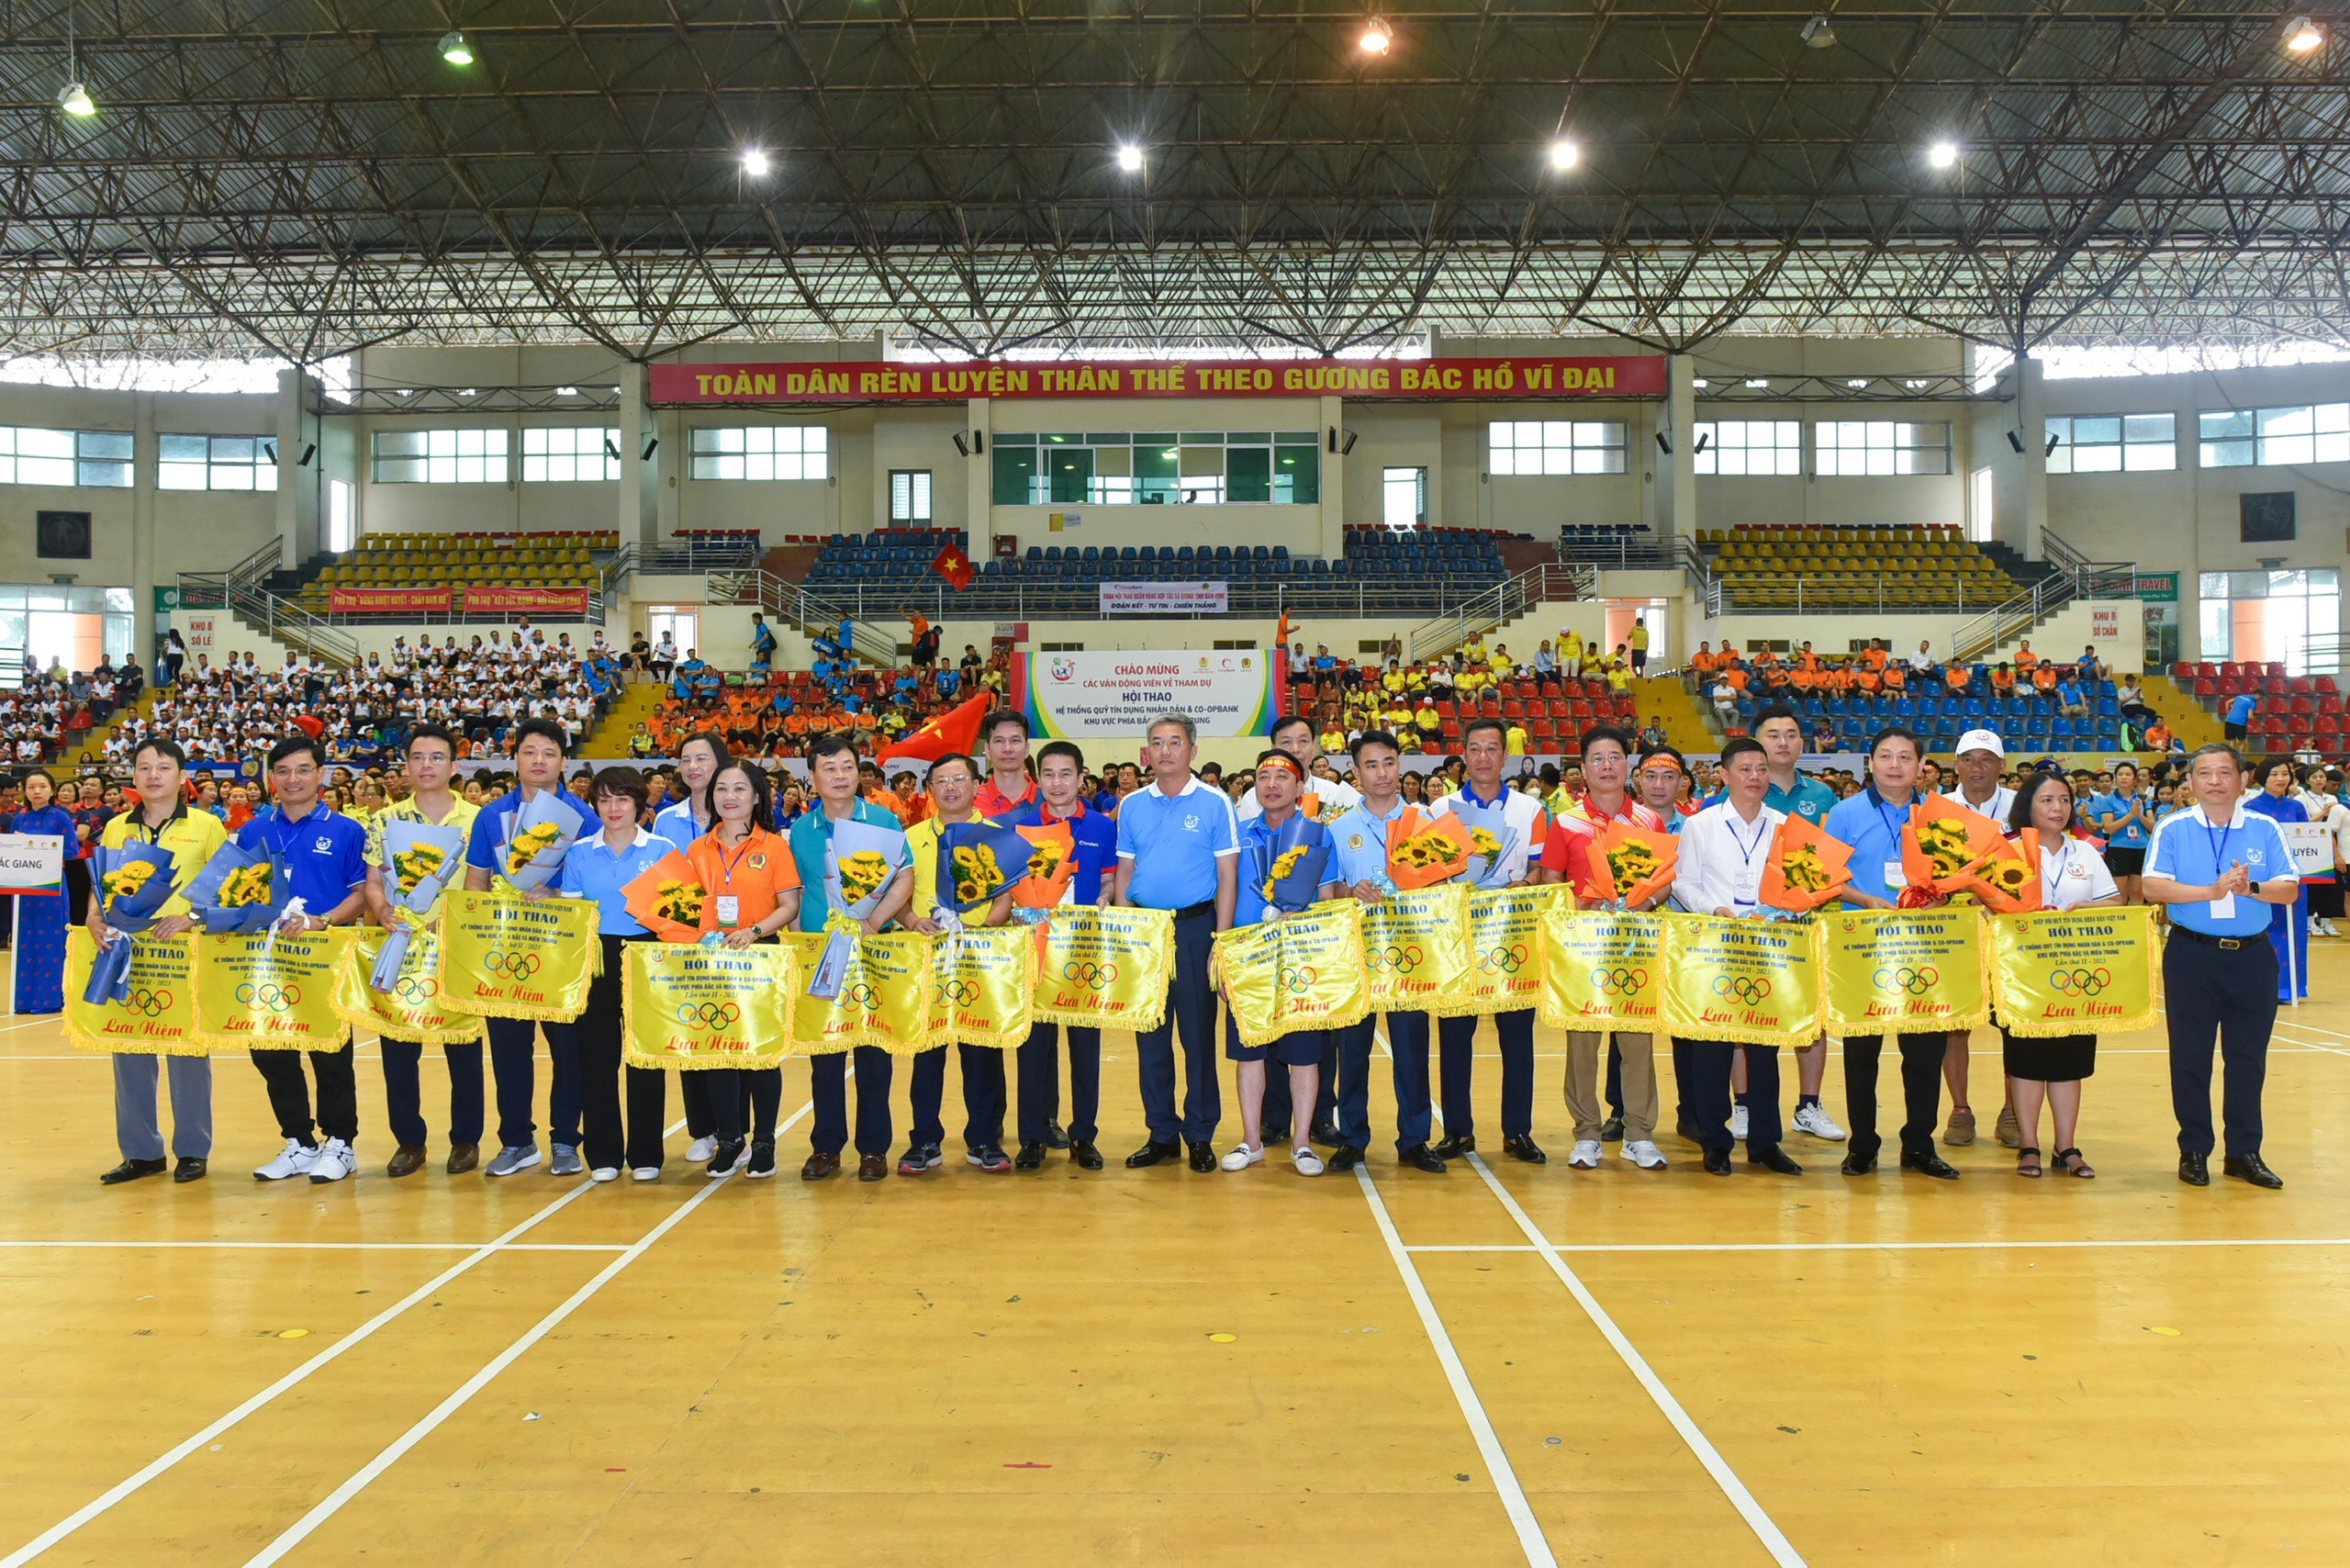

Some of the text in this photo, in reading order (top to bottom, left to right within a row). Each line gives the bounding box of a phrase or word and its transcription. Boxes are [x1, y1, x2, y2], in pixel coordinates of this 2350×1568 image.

[696, 361, 1615, 396] TOÀN DÂN RÈN LUYỆN THÂN THỂ THEO GƯƠNG BÁC HỒ VĨ ĐẠI
[2136, 578, 2172, 590] TRAVEL
[2094, 611, 2116, 622] KHU B
[191, 621, 212, 631] KHU B
[2093, 626, 2100, 636] SỐ
[191, 633, 201, 645] SỐ
[1114, 663, 1144, 675] CHÀO
[1147, 663, 1179, 675] MỪNG
[1083, 678, 1098, 688] CÁC
[1100, 678, 1116, 689] VẬN
[1118, 678, 1141, 689] ĐỘNG
[1144, 678, 1160, 687] VIÊN
[1201, 679, 1212, 689] DỰ
[1123, 689, 1171, 704] HỘI THAO
[1056, 705, 1065, 716] HỆ
[1067, 704, 1091, 714] THỐNG
[1093, 705, 1109, 714] QUỸ
[1110, 705, 1122, 713] TÍN
[1124, 707, 1144, 716] DỤNG
[1146, 704, 1168, 713] NHÂN
[1169, 704, 1185, 713] DÂN
[1194, 705, 1239, 713] CO-OPBANK
[1102, 717, 1116, 726] VỰC
[1118, 716, 1135, 724] PHÍA
[2293, 846, 2318, 857] UYÊN
[0, 856, 42, 868] ẮC GIANG
[494, 908, 558, 924] HỘI THAO
[1070, 919, 1132, 933] HỘI THAO
[1874, 924, 1944, 937] HỘI THAO
[2048, 925, 2113, 938] HỘI THAO
[1720, 933, 1786, 947] HỘI THAO
[684, 958, 753, 971] HỘI THAO
[474, 980, 545, 1004] Lưu Niệm
[1052, 991, 1125, 1014] Lưu Niệm
[1580, 999, 1656, 1019] Lưu Niệm
[1863, 999, 1951, 1017] Lưu Niệm
[2042, 1001, 2124, 1018] Lưu Niệm
[1699, 1006, 1779, 1028] Lưu Niệm
[102, 1018, 183, 1039] Lưu Niệm
[224, 1015, 310, 1034] Lưu Niệm
[665, 1034, 750, 1054] Lưu Niệm
